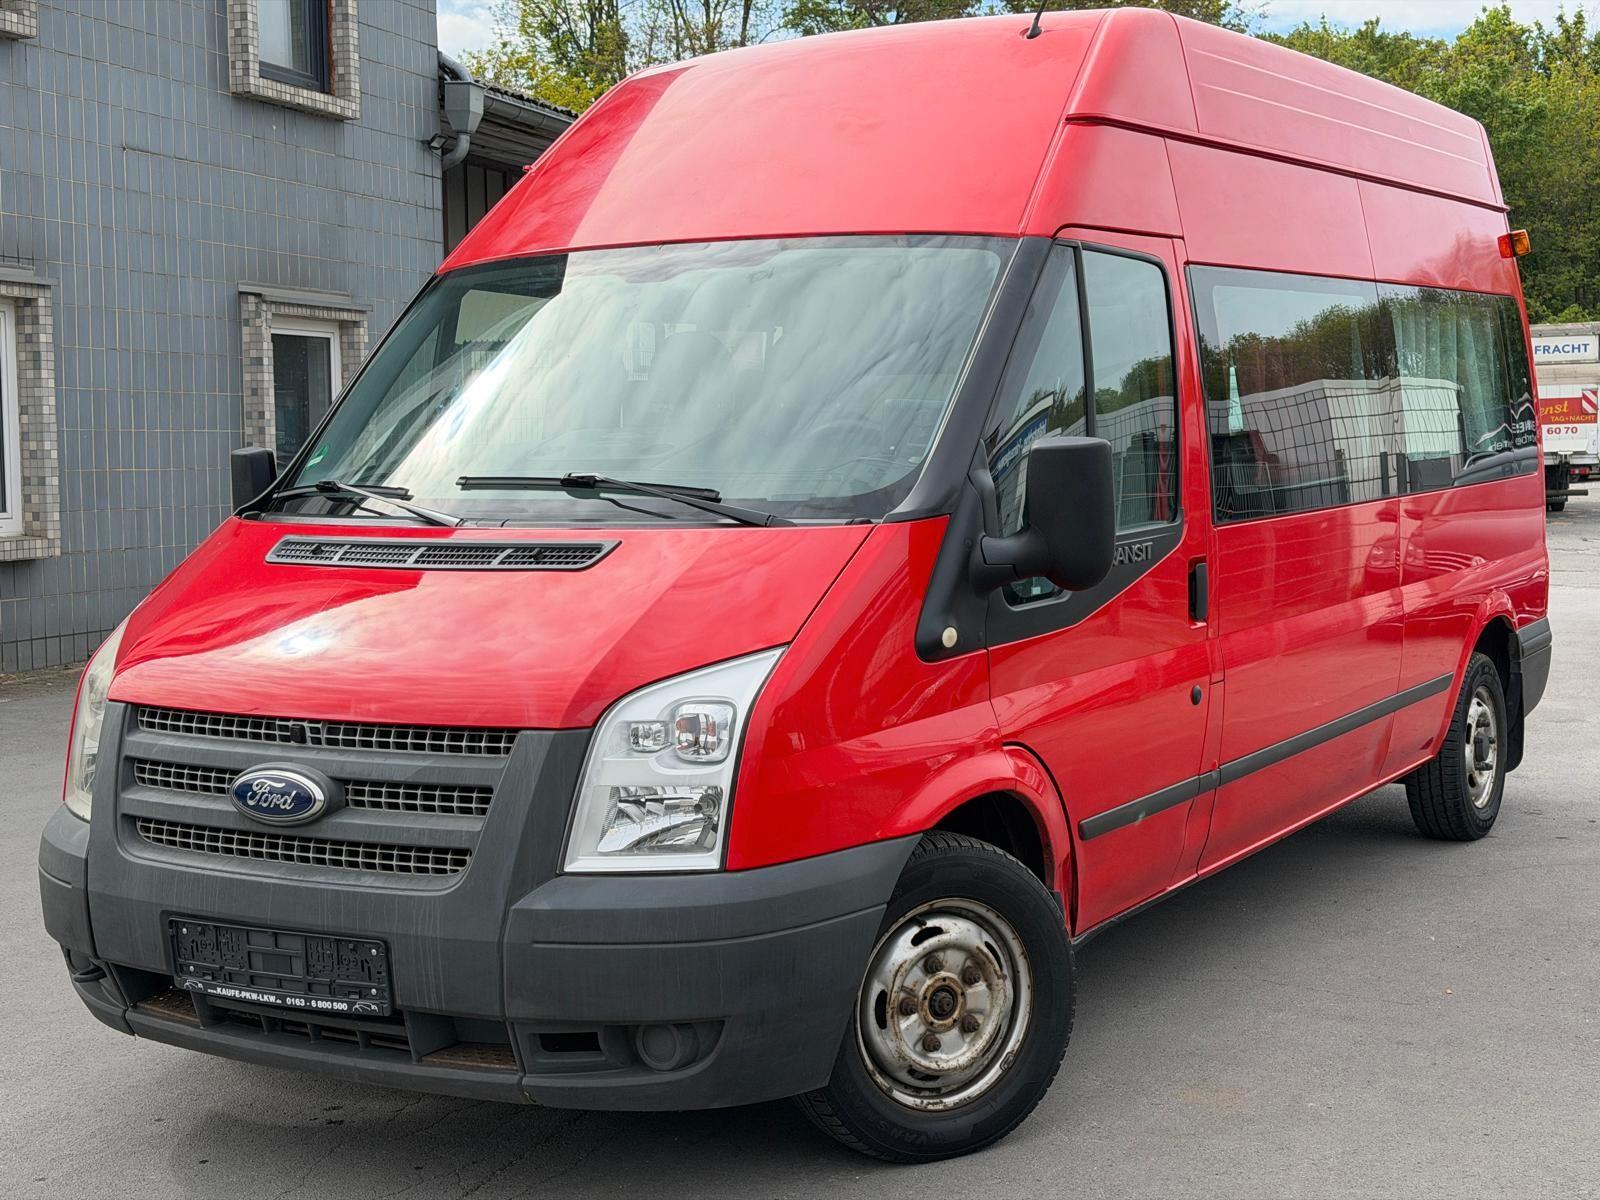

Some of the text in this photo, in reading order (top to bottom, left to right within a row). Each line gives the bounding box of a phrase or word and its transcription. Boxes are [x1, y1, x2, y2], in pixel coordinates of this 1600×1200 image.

[1534, 343, 1589, 354] FRACHT
[1547, 426, 1578, 435] 60 70
[1112, 542, 1153, 565] ANSIT
[246, 779, 297, 810] Ford
[286, 997, 304, 1006] 0163
